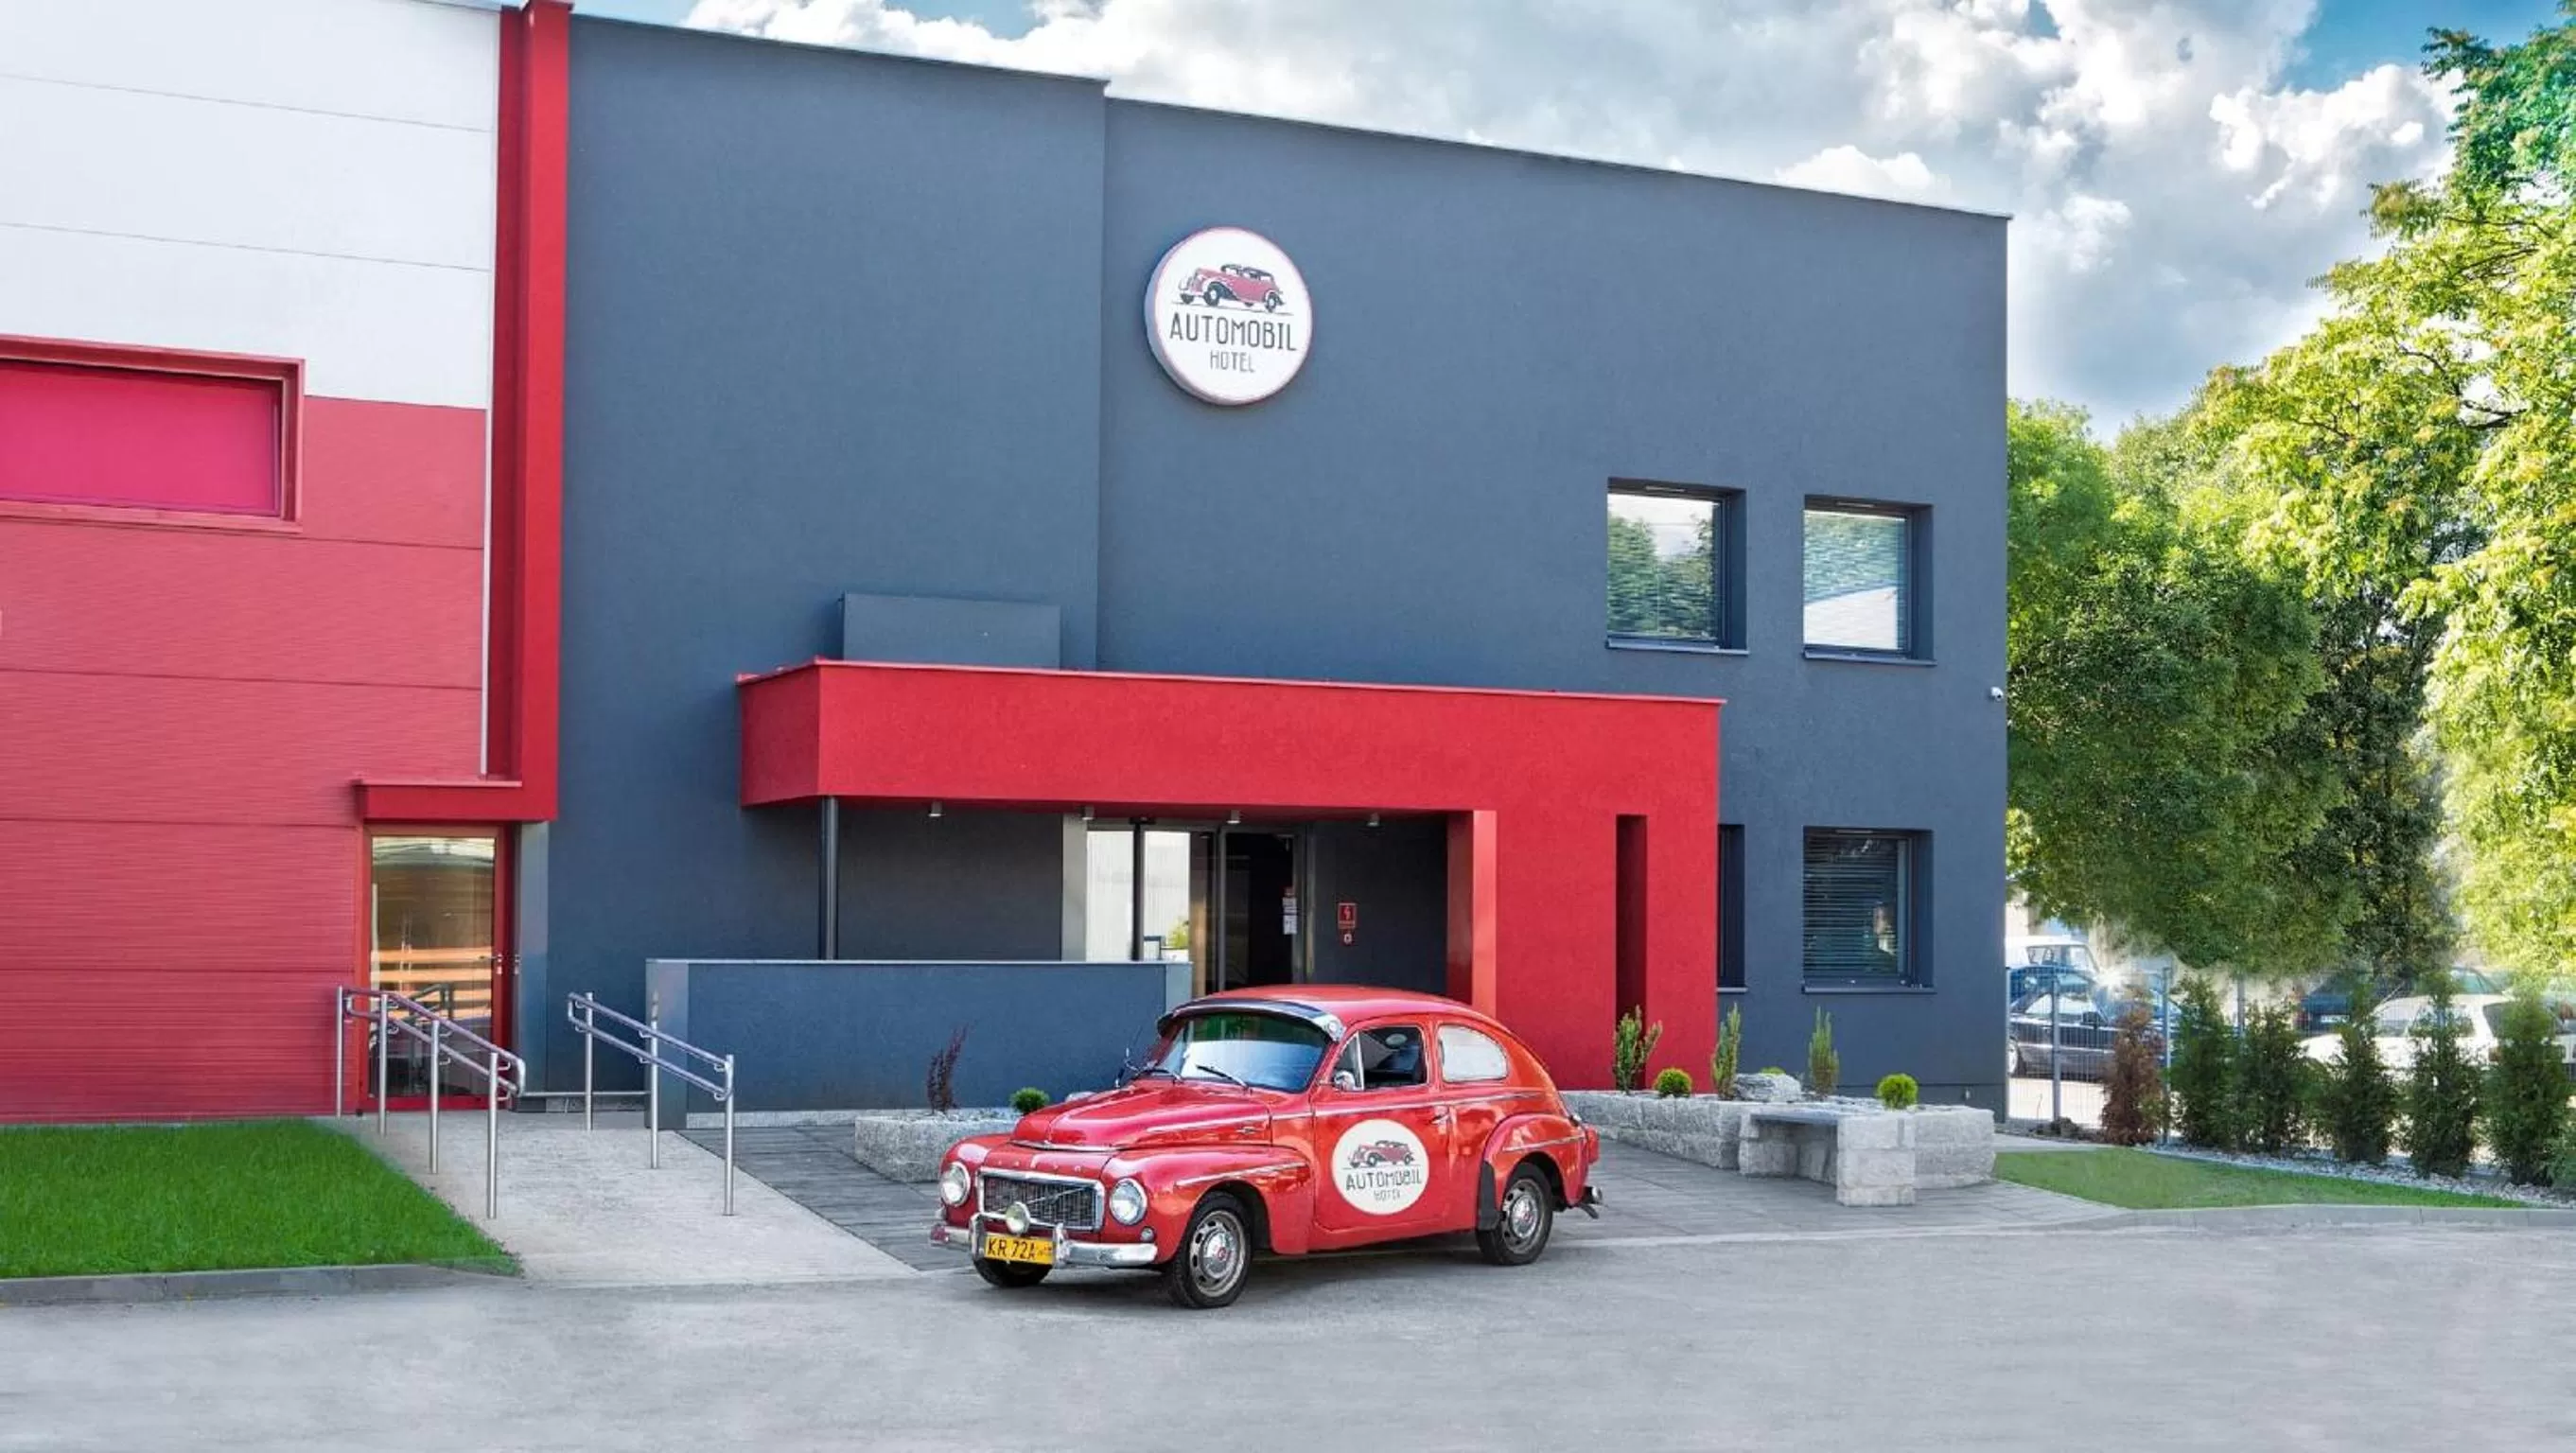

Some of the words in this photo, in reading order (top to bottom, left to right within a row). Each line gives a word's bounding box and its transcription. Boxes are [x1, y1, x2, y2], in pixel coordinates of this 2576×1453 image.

[1169, 312, 1297, 351] AUTOMOBIL
[1210, 350, 1255, 373] HOTEL
[1345, 1168, 1422, 1191] AUTOMOBIL
[988, 1236, 1008, 1258] KR
